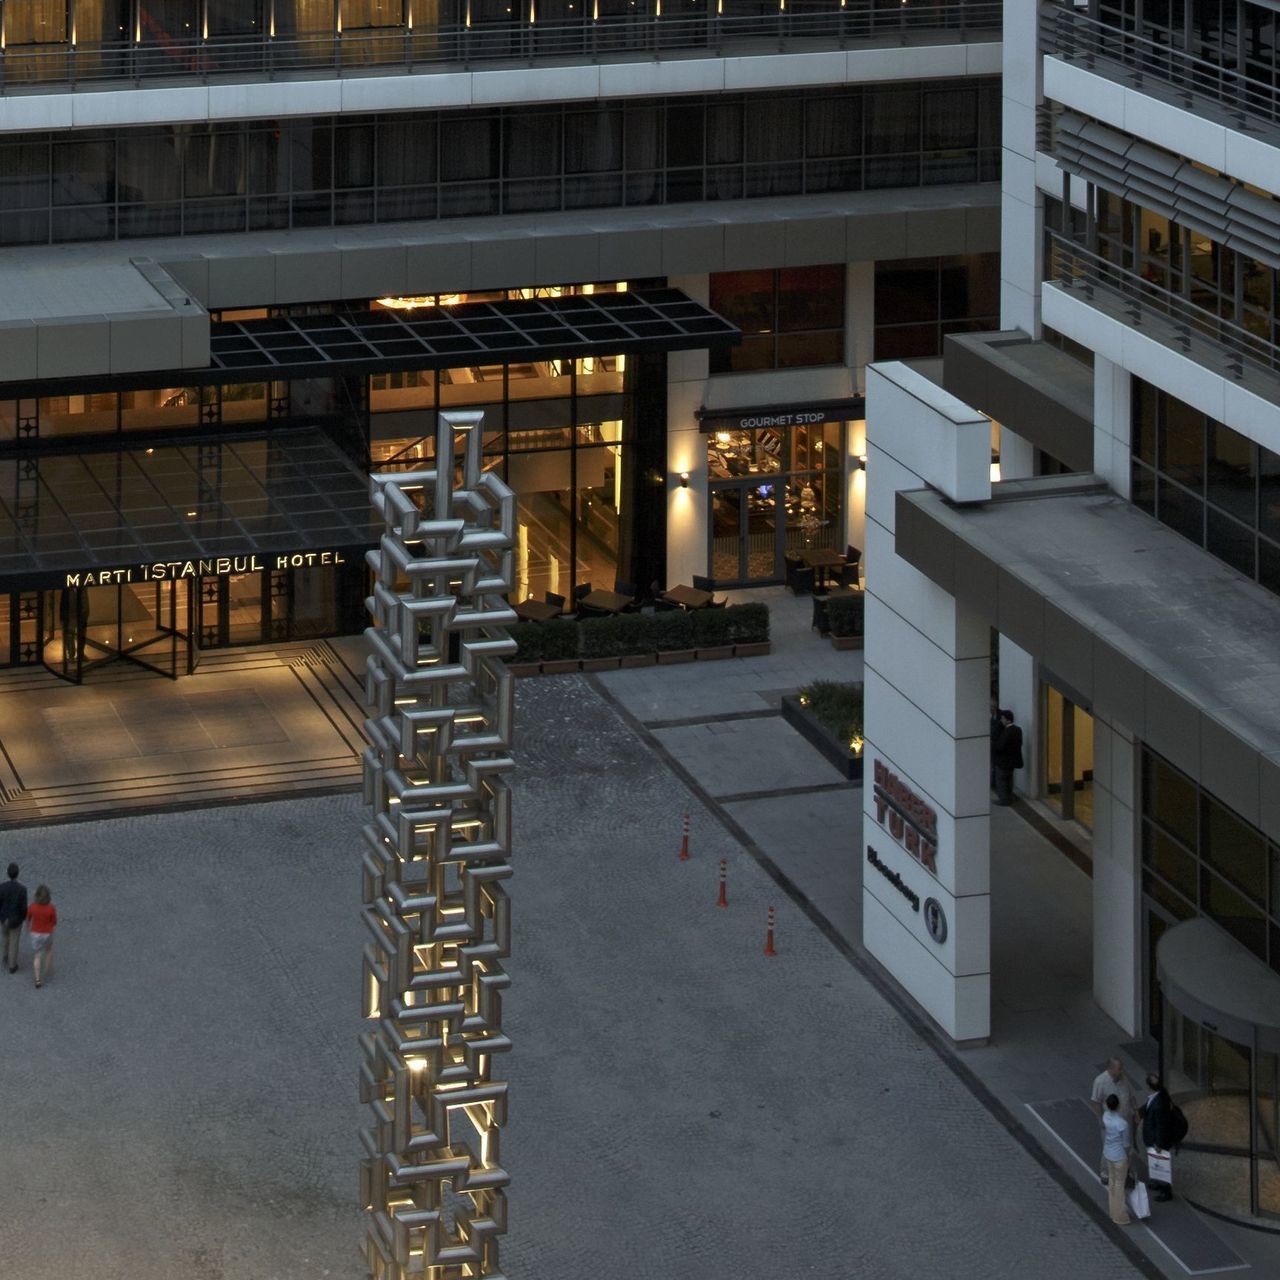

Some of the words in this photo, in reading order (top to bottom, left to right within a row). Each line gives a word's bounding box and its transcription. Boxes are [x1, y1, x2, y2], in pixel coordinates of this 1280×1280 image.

[740, 414, 793, 428] GOURMET
[795, 412, 825, 424] STOP
[66, 569, 132, 587] MARTI
[277, 551, 346, 569] HOTEL
